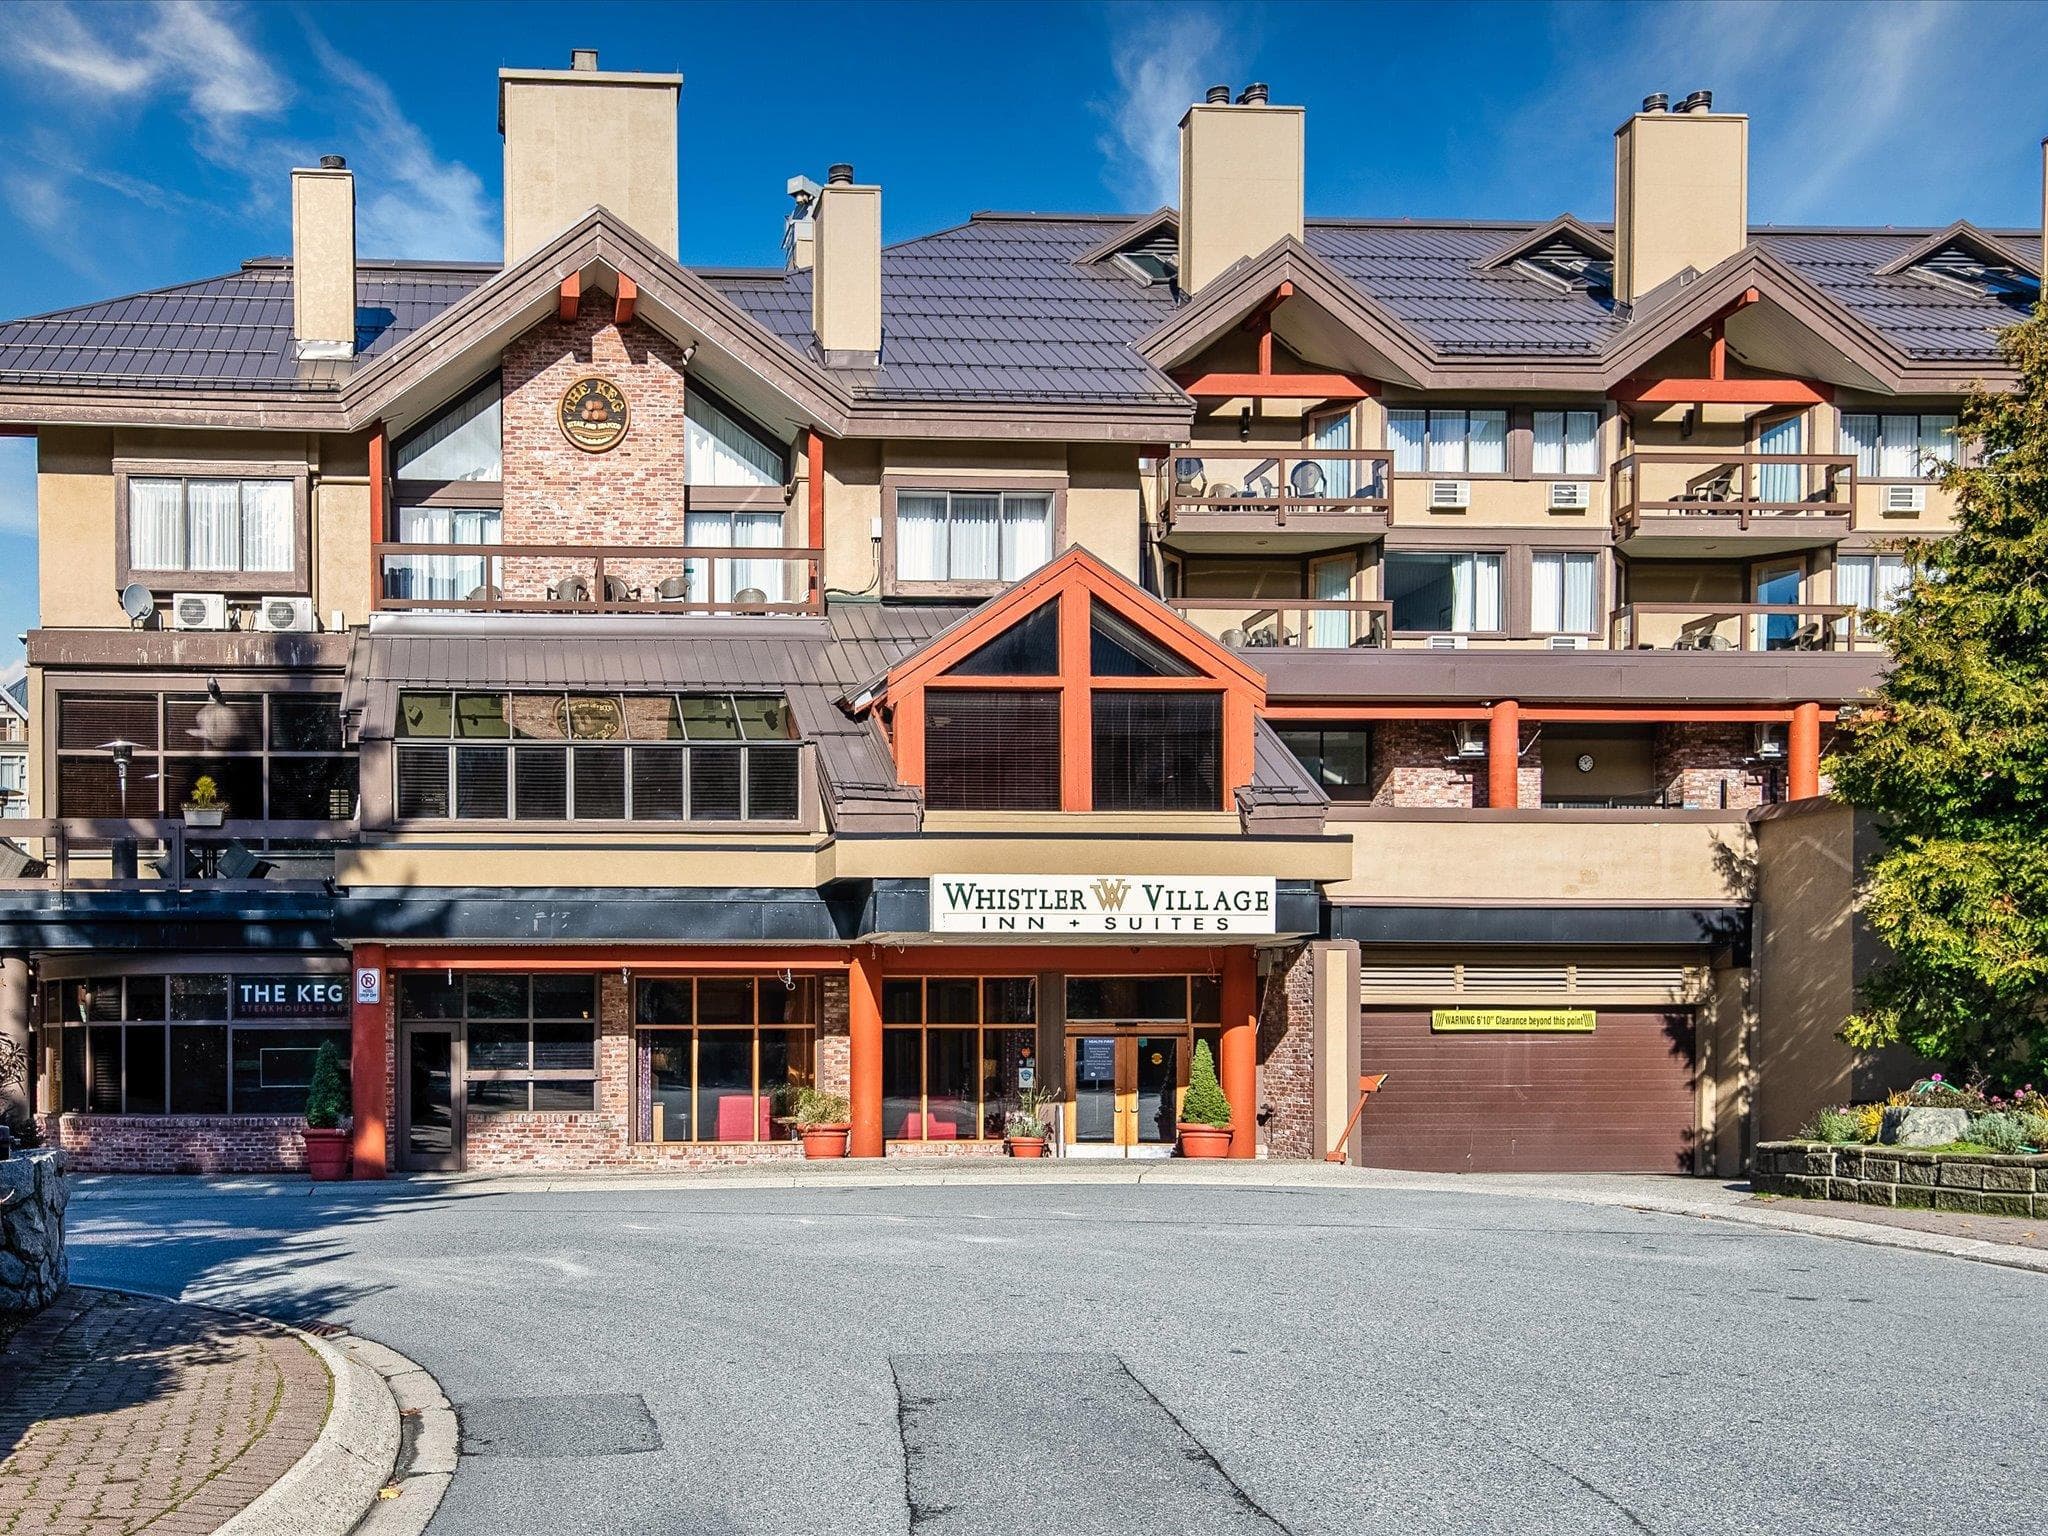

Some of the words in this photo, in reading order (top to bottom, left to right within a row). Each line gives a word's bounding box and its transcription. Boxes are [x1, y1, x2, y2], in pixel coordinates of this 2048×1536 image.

[563, 382, 591, 413] THE
[595, 381, 625, 412] KEG
[942, 883, 1088, 910] WHISTLER
[1142, 884, 1270, 911] VILLAGE
[981, 916, 1045, 930] INN
[1105, 917, 1230, 930] SUITES
[240, 984, 286, 1003] THE
[297, 984, 343, 1003] KEG
[240, 1005, 313, 1013] STEAKHOUSE
[322, 1005, 343, 1013] BAR
[1444, 1016, 1475, 1025] WARNING
[1495, 1016, 1527, 1025] Clearance
[1528, 1016, 1552, 1027] beyond
[1553, 1016, 1566, 1025] this
[1567, 1016, 1584, 1027] point
